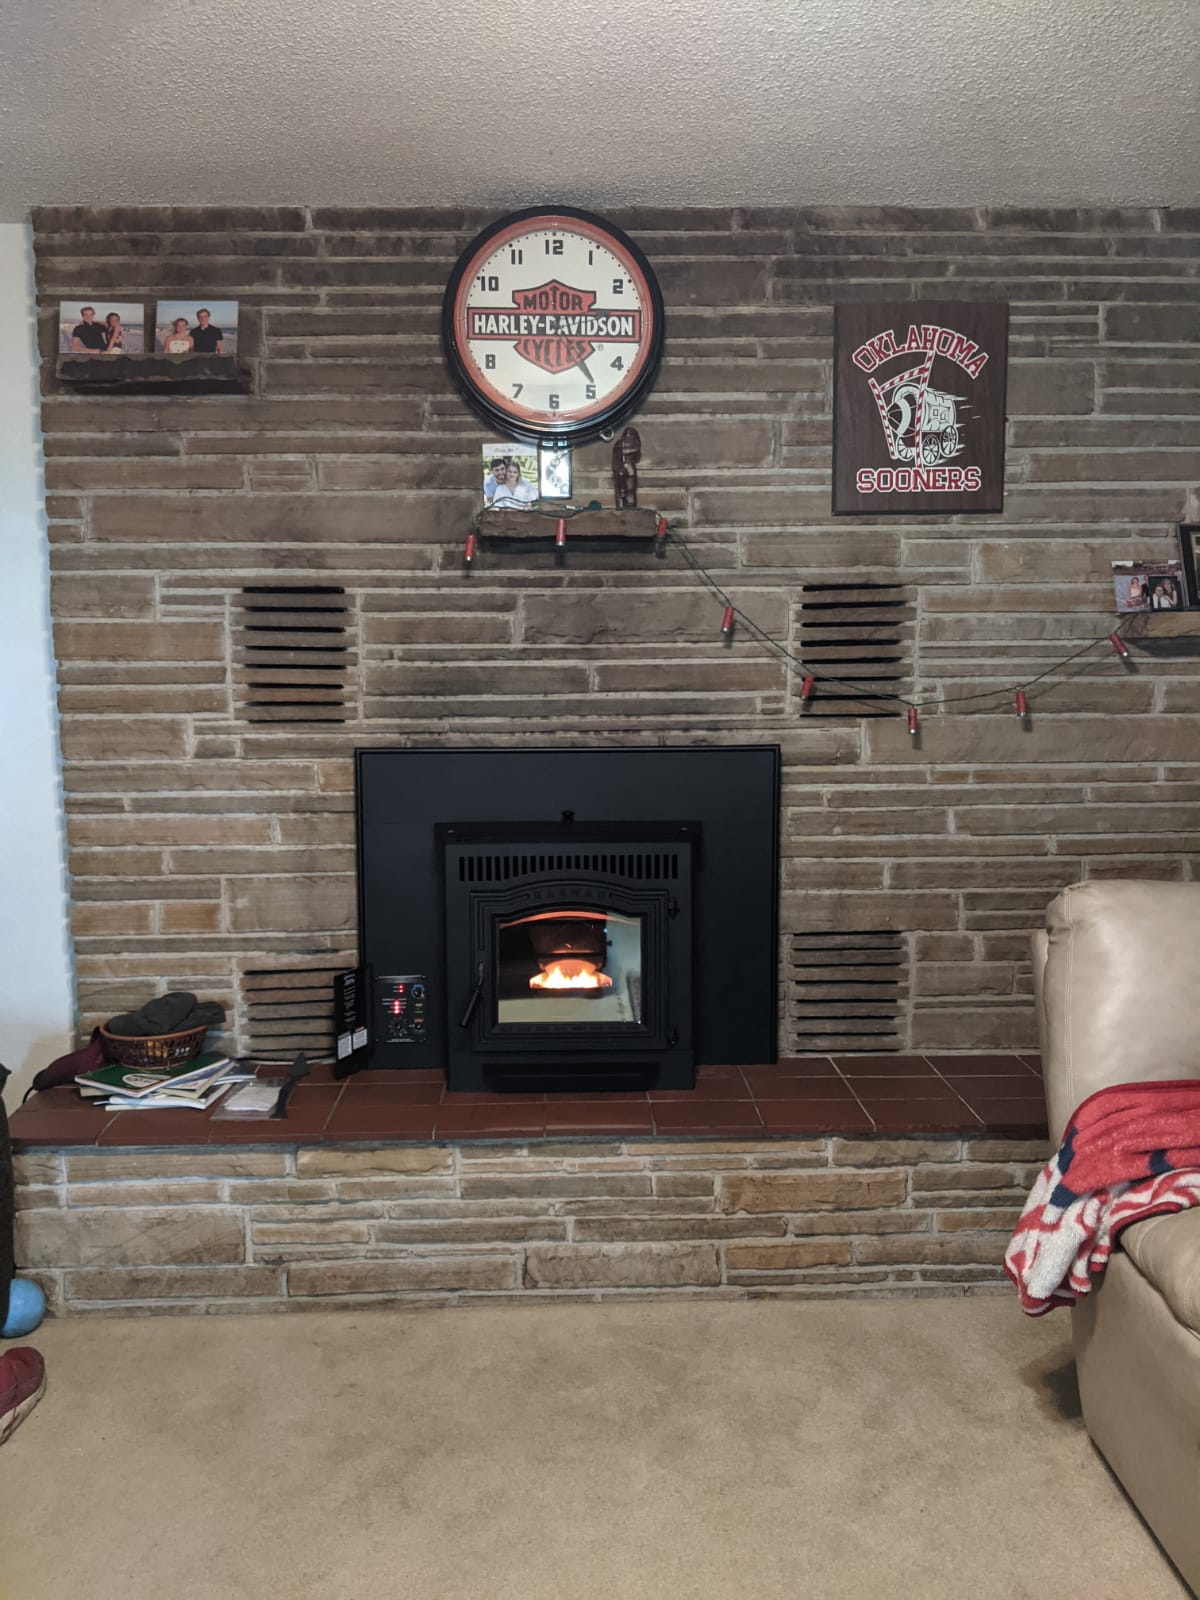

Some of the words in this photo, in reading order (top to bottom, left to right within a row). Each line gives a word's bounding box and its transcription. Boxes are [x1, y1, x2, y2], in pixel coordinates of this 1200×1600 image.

[545, 239, 564, 255] 12
[511, 249, 523, 265] 11
[588, 250, 594, 266] 1
[480, 276, 499, 292] 10
[612, 279, 624, 295] 2
[523, 286, 583, 311] MOTOR
[474, 314, 633, 336] HARLEY-DAVIDSON
[523, 339, 587, 367] CYCLES
[852, 324, 989, 379] OKLAHOMA
[485, 354, 496, 369] 8
[610, 356, 624, 371] 4
[512, 383, 524, 399] 7
[585, 384, 597, 400] 5
[549, 394, 560, 410] 6
[856, 466, 982, 493] SOONERS
